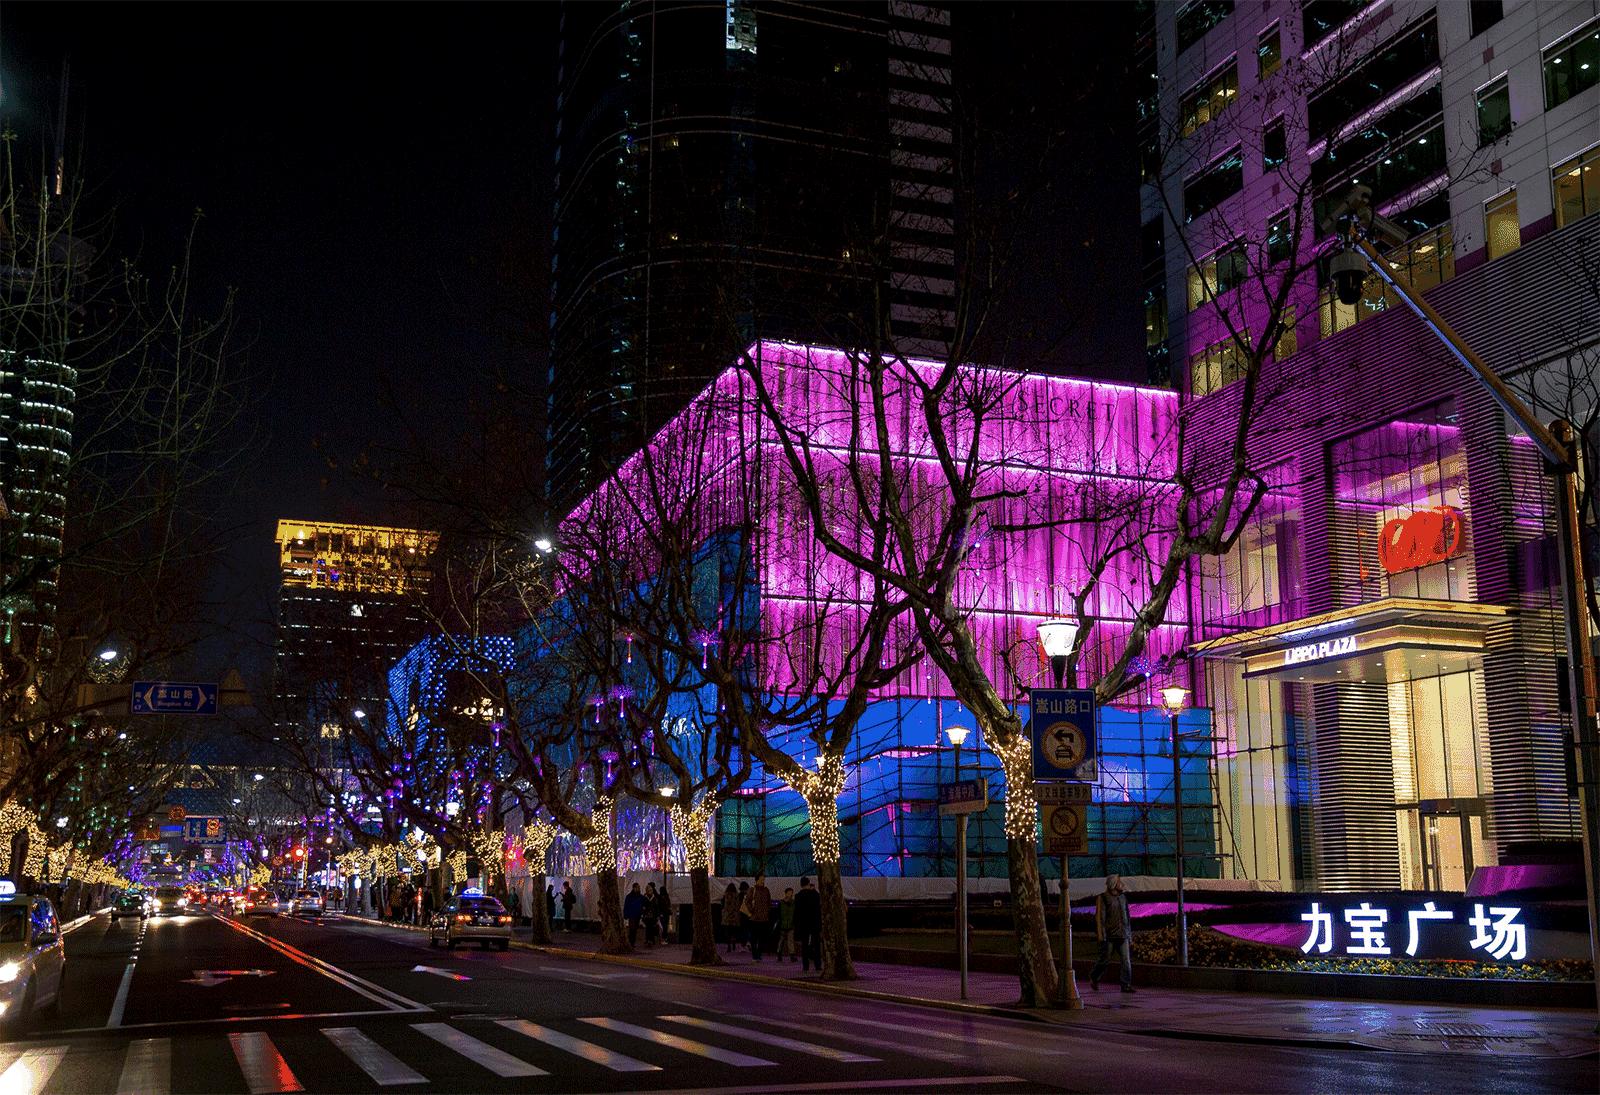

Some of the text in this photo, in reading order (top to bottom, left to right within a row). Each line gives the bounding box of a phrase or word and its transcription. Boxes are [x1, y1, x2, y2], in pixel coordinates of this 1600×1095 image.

[1285, 636, 1357, 665] LIPPO PLAZA
[1036, 698, 1091, 714] 嵩山路口
[1301, 902, 1527, 961] 力宝广场
